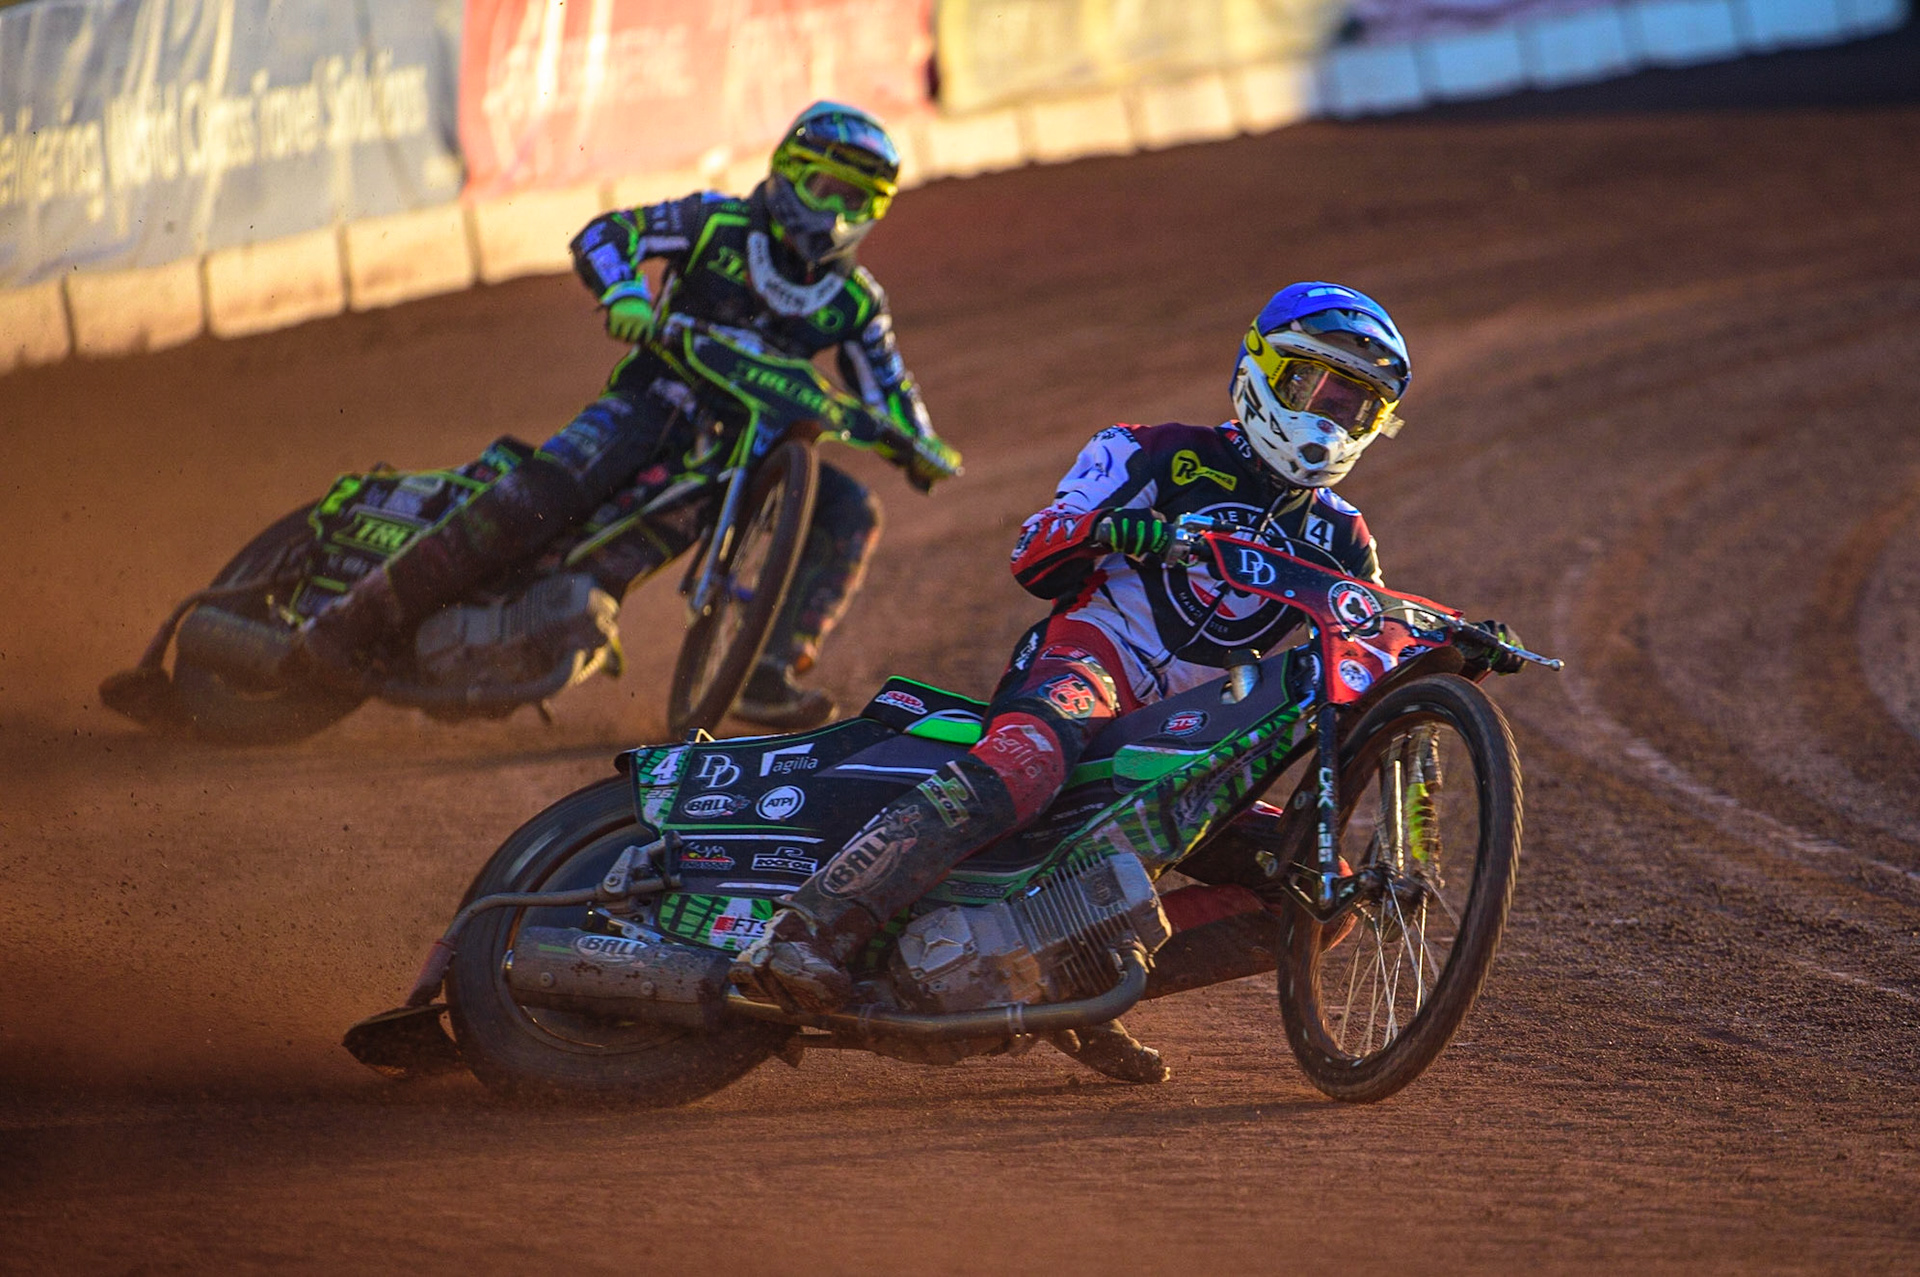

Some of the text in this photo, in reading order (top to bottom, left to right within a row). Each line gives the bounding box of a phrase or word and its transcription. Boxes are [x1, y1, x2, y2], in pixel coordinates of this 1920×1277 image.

[1233, 435, 1252, 459] FTS
[1310, 520, 1330, 551] 4
[650, 751, 682, 780] 4
[772, 757, 819, 775] agilia
[765, 797, 795, 808] ATPI
[757, 859, 813, 871] ROCK OIL
